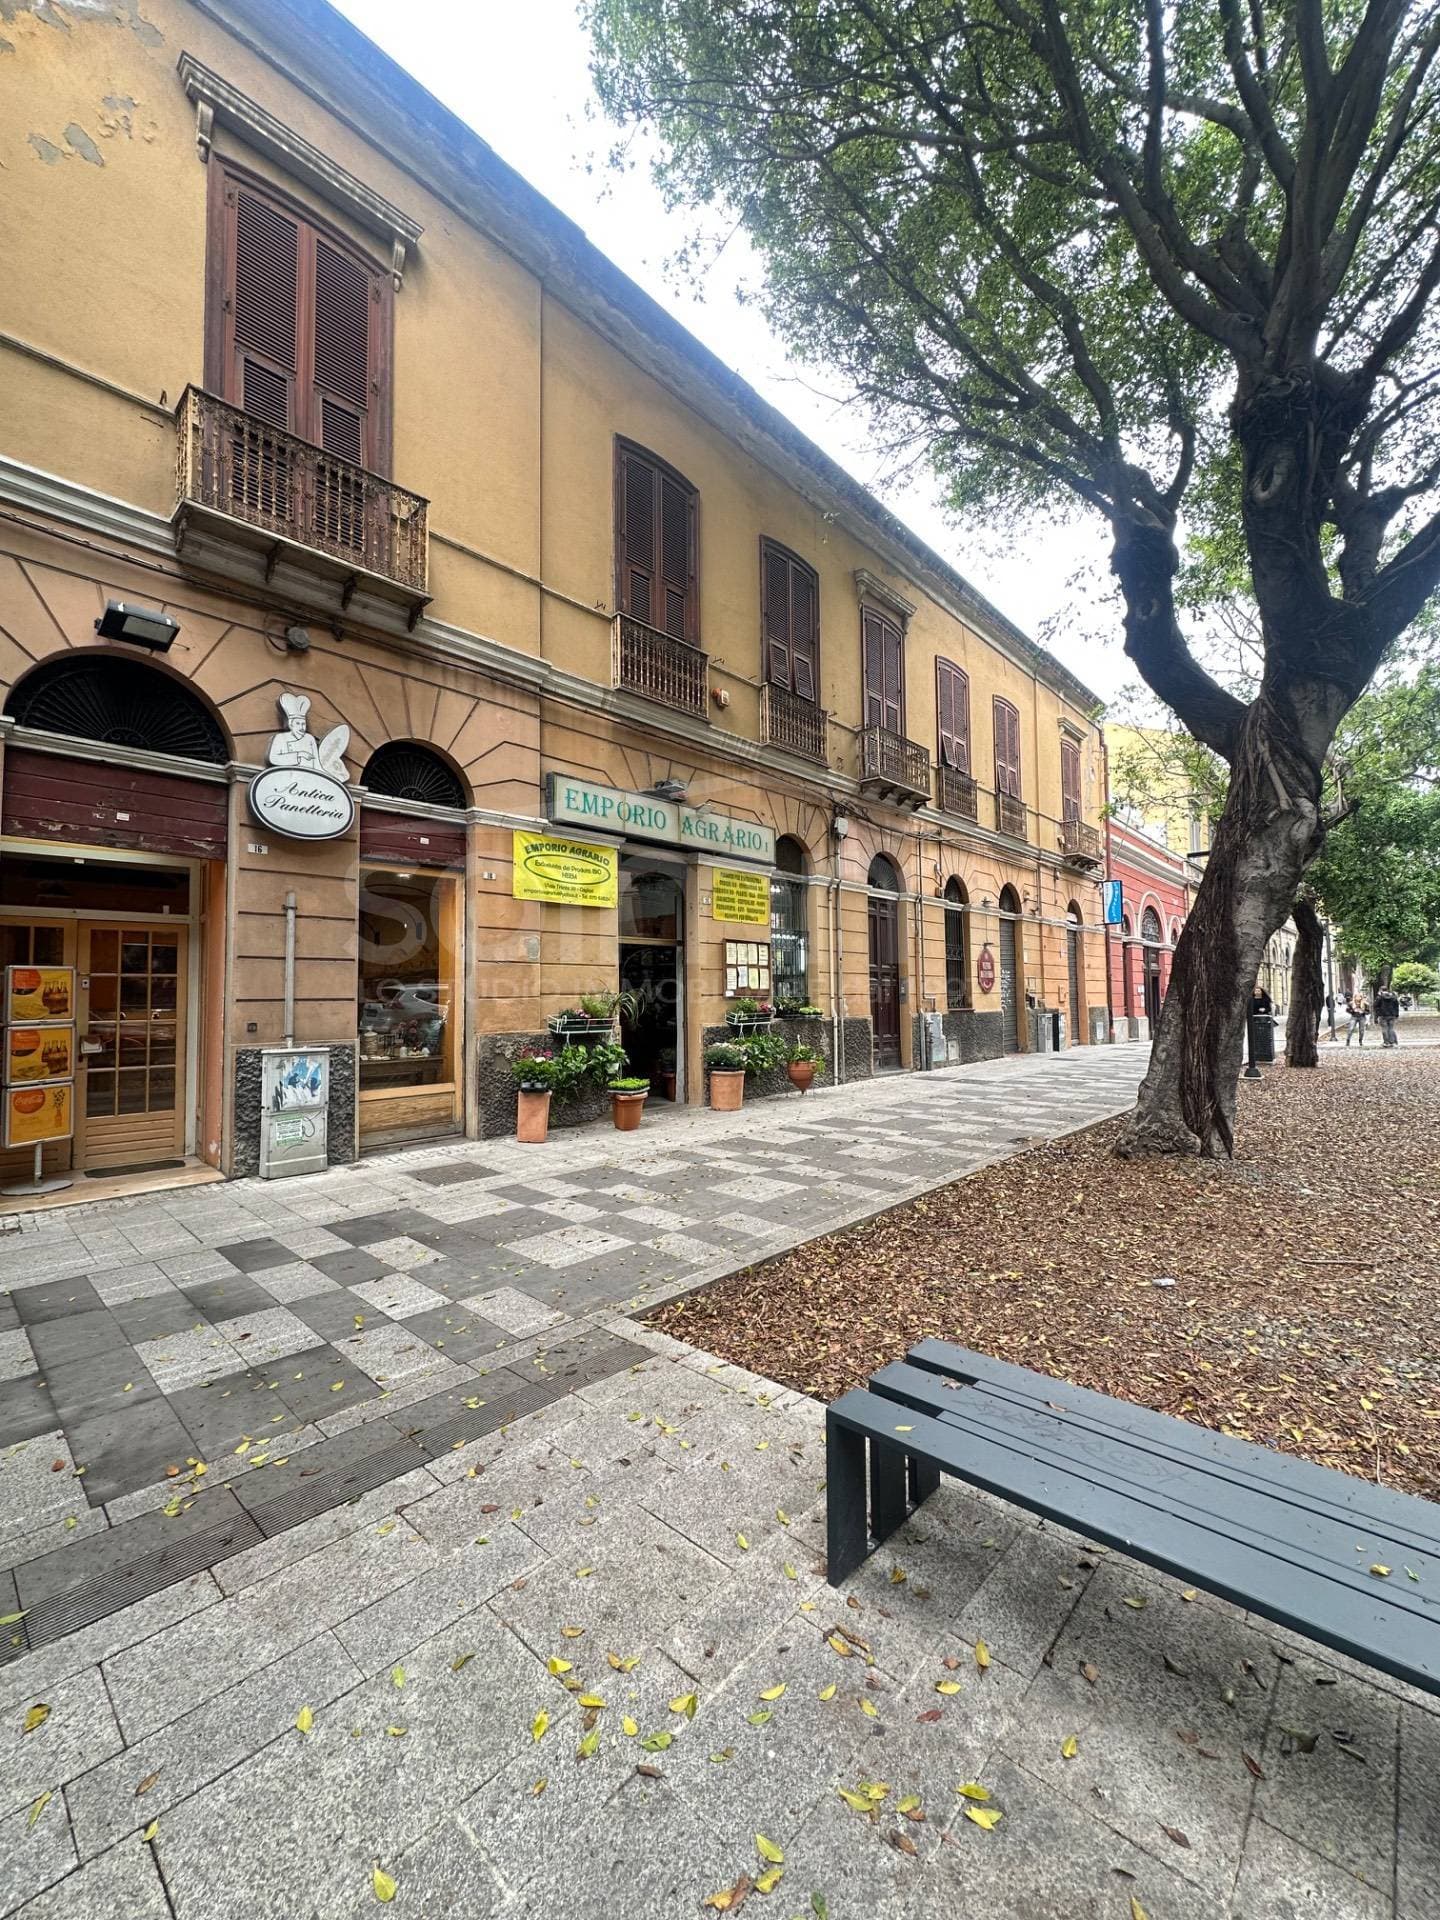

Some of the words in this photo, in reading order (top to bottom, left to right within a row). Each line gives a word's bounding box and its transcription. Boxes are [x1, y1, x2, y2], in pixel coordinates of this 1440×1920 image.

[274, 781, 335, 802] Antica
[263, 795, 344, 819] Panetteria
[565, 787, 667, 830] EMPORIO
[681, 816, 762, 850] AGRARIO
[254, 845, 263, 853] 16
[524, 843, 567, 854] EMPORIO
[569, 847, 610, 866] AGRARIO
